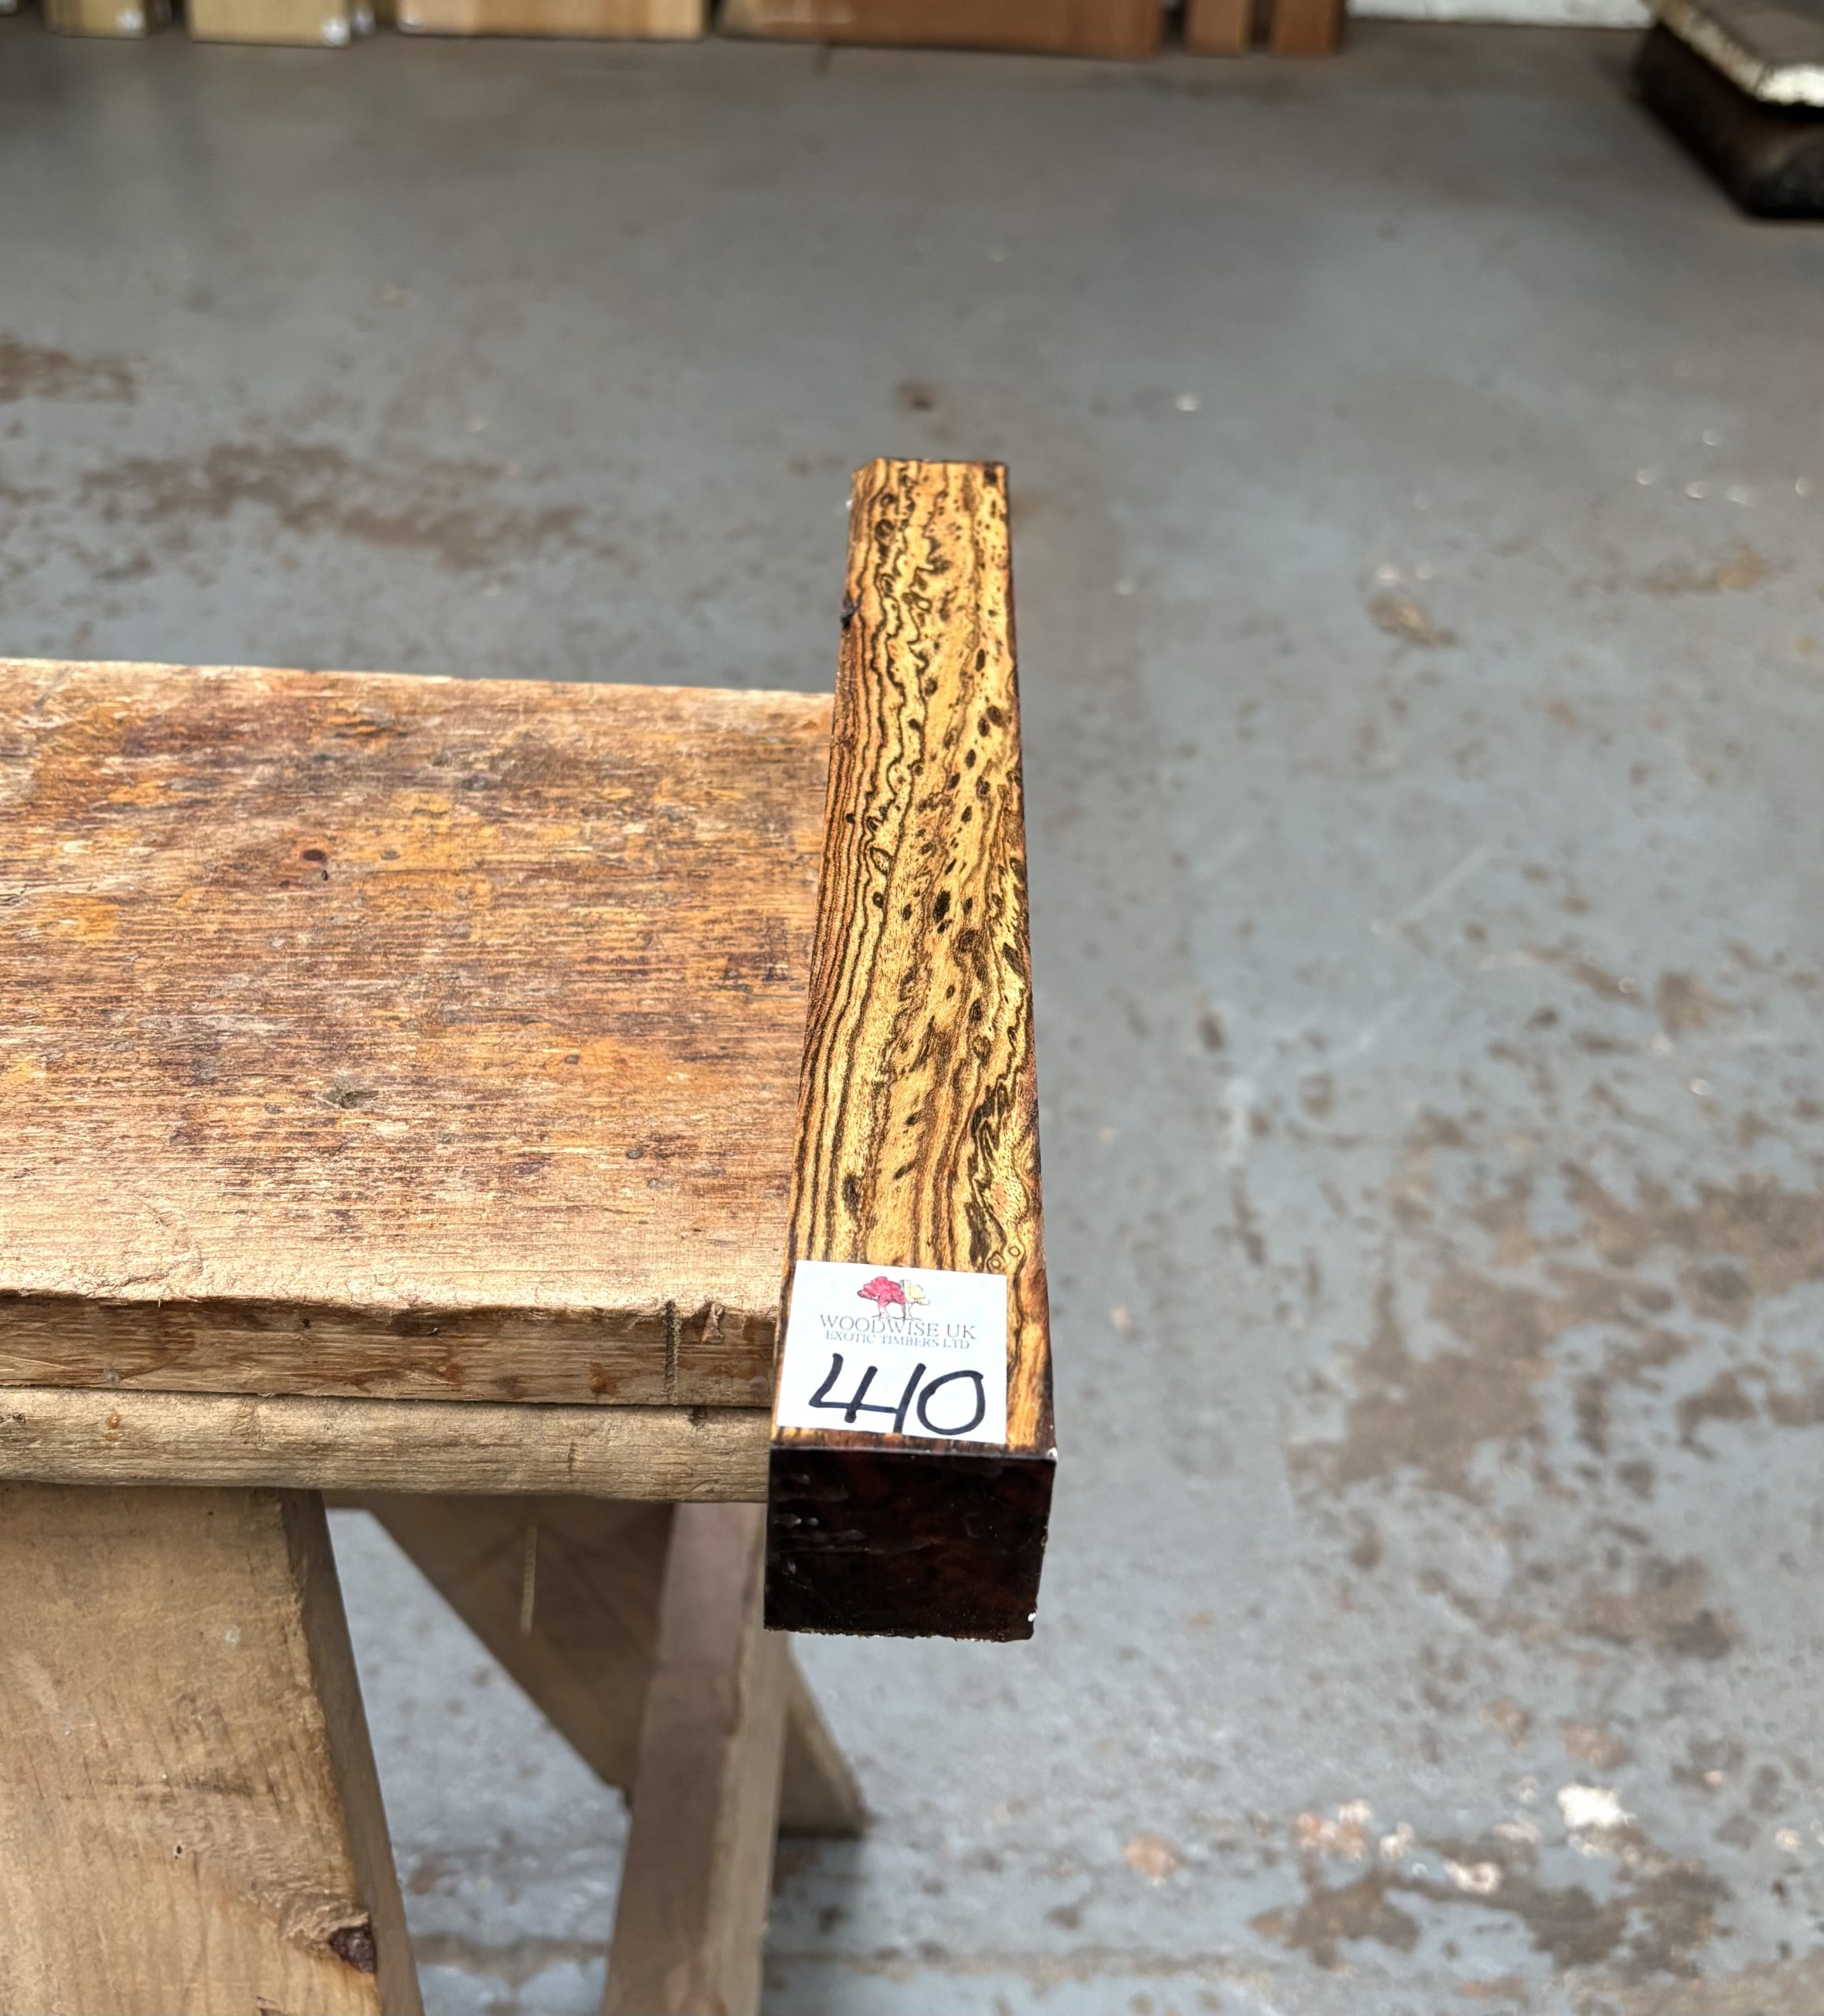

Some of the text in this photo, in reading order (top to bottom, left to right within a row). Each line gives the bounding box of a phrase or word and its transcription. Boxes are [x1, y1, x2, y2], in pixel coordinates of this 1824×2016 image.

[820, 1314, 977, 1340] WOODWISE UK
[825, 1330, 969, 1350] EXOTIC TIMBERS LTD
